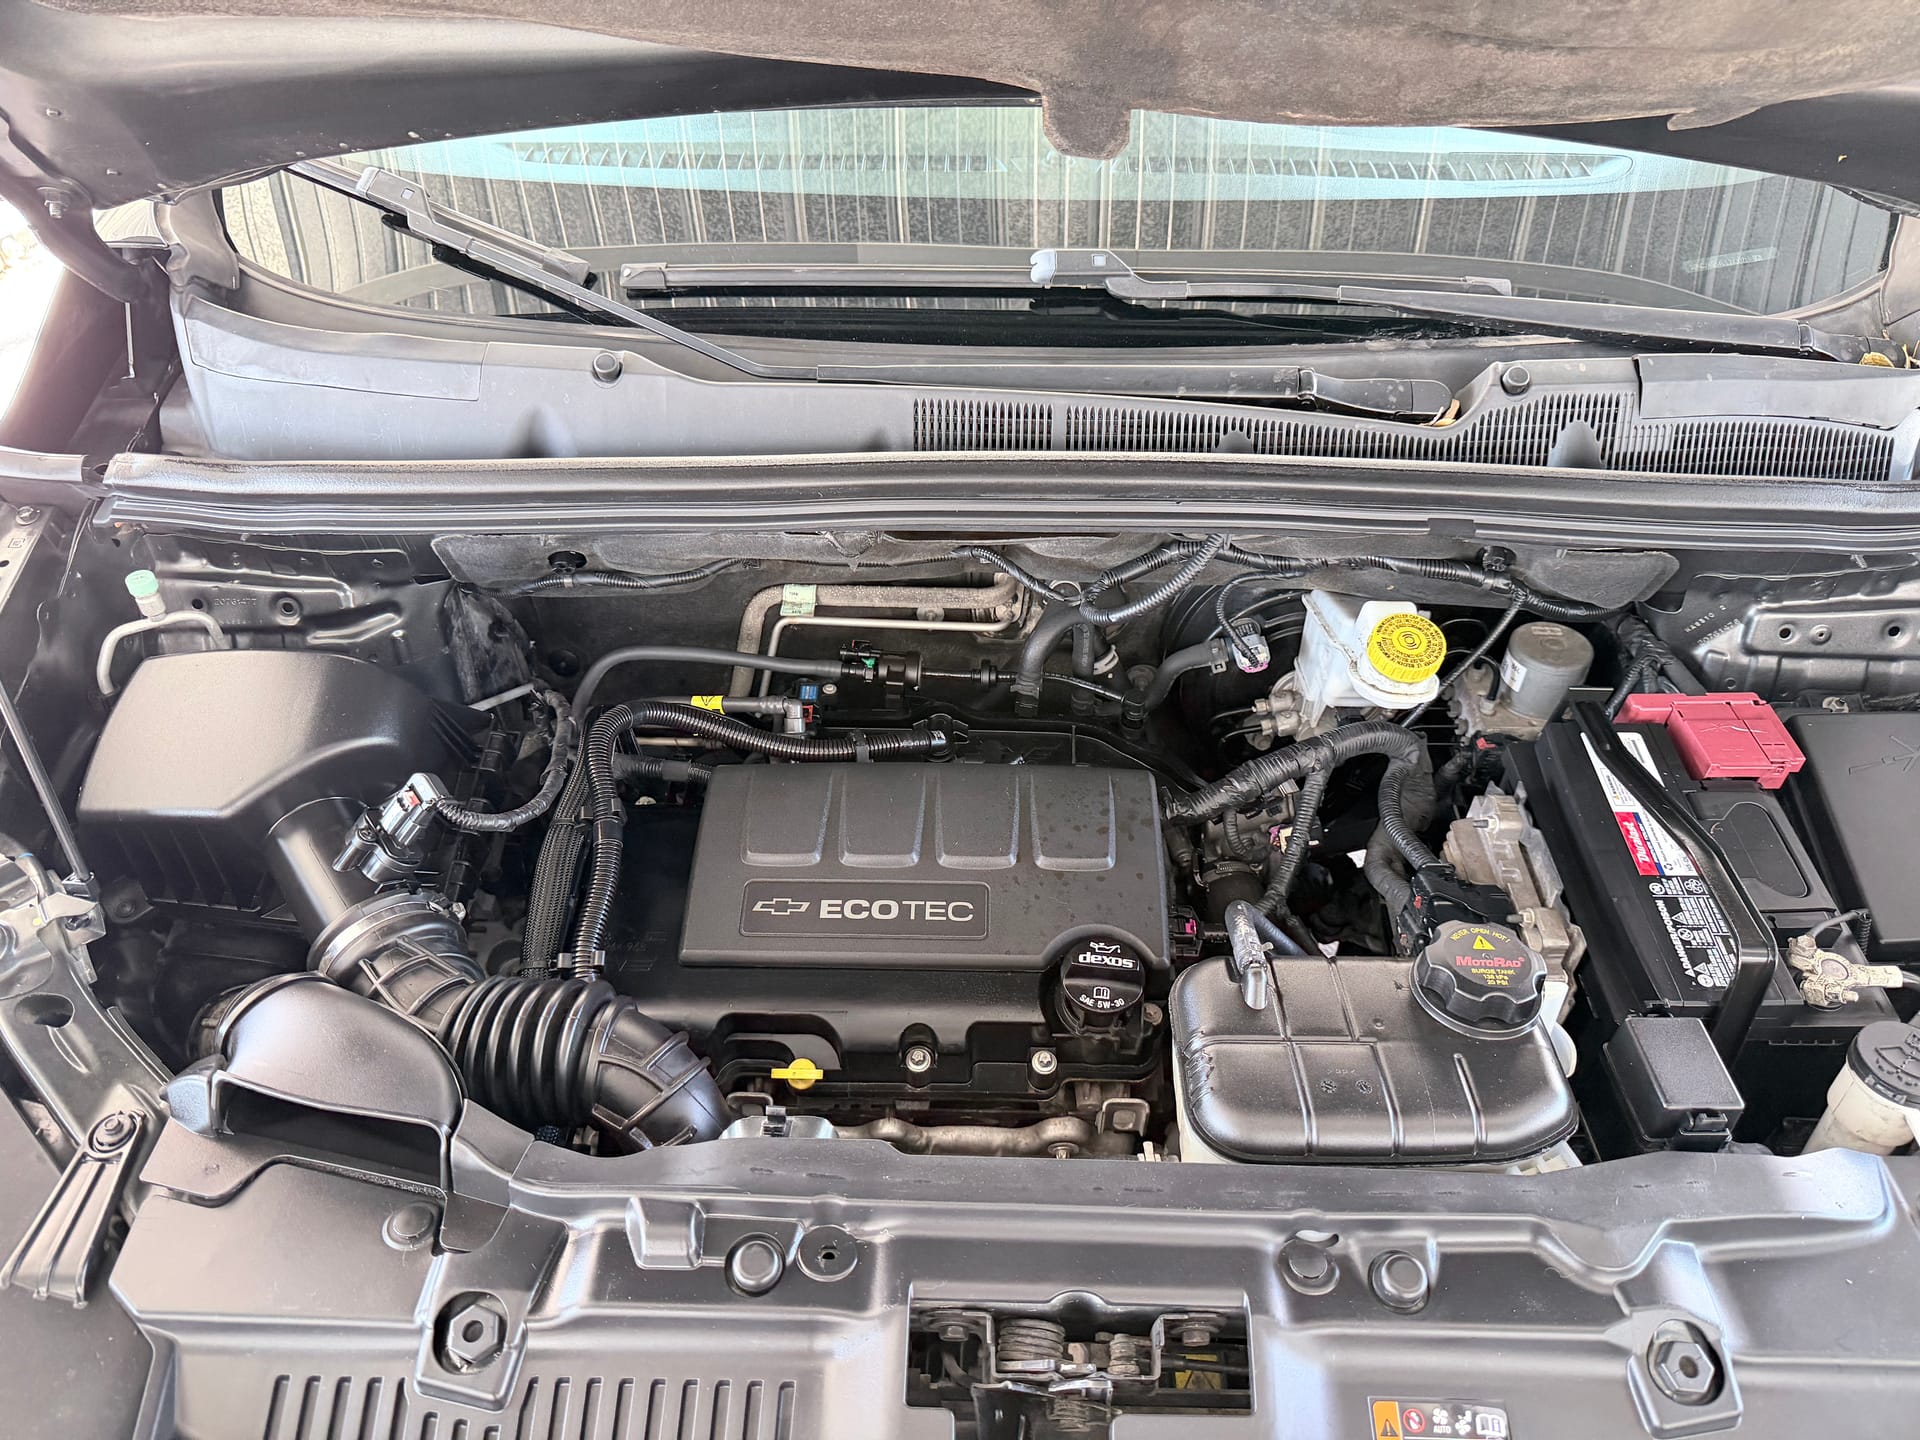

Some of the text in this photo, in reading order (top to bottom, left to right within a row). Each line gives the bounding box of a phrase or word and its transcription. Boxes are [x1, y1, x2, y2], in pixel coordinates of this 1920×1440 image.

[1622, 821, 1650, 864] Duralast
[819, 899, 974, 922] ECOTEC
[1655, 900, 1691, 969] DANGER/POISON
[1079, 952, 1136, 968] dexos
[1080, 994, 1125, 1009] SAE 5W-30
[1433, 1425, 1451, 1434] AUTO
